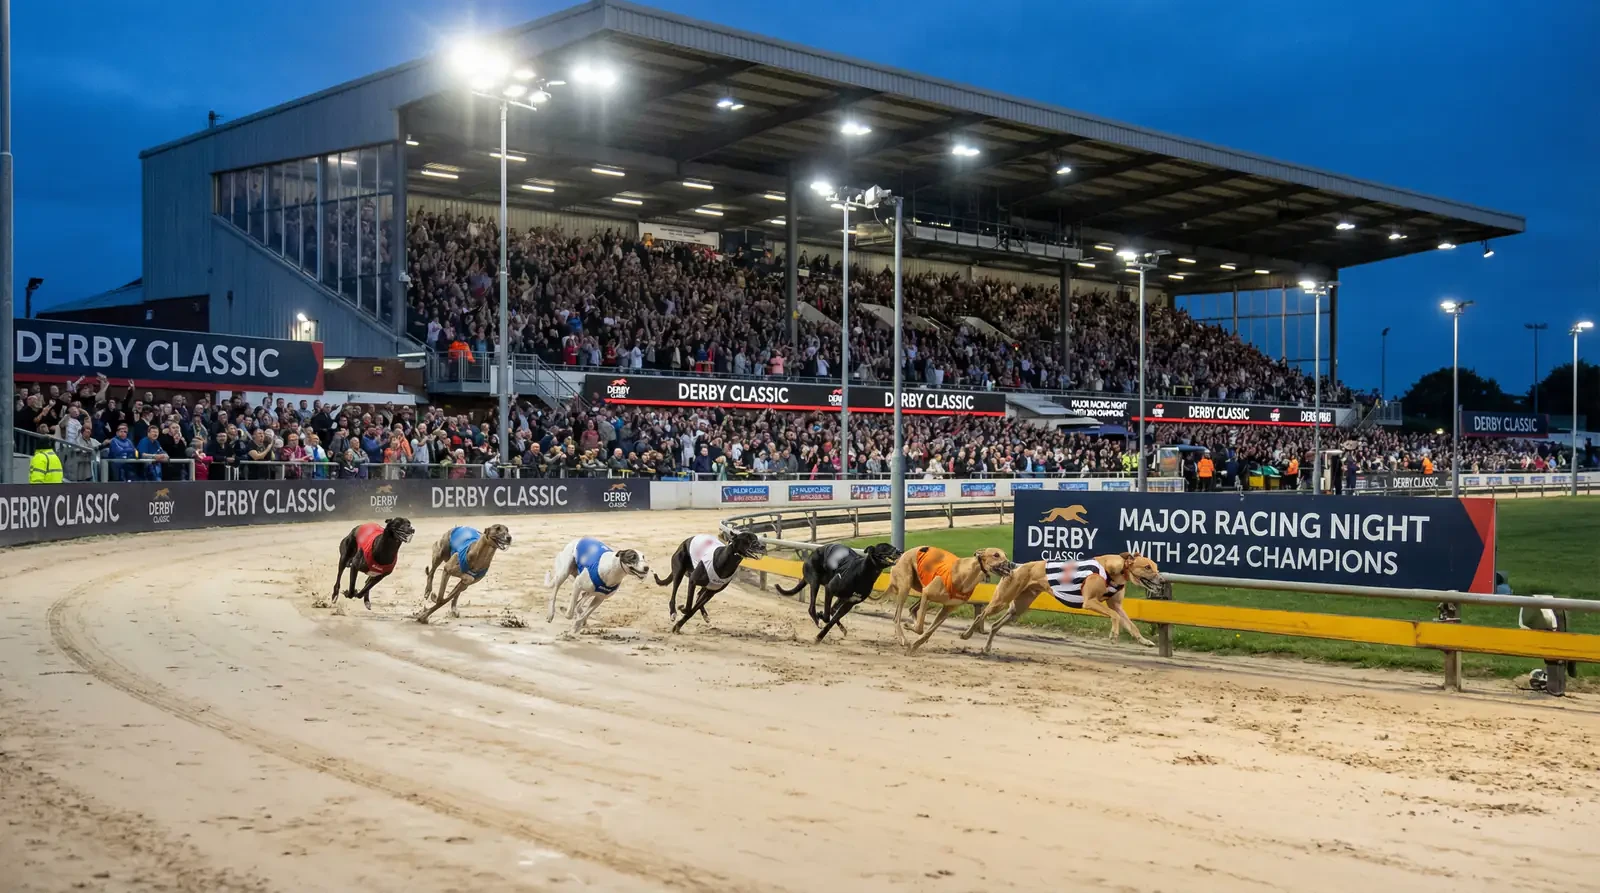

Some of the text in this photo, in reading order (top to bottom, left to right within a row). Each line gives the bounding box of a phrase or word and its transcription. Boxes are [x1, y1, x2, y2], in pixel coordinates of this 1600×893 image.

[16, 330, 280, 378] DERBY CLASSIC
[678, 383, 789, 403] DERBY CLASSIC
[885, 392, 974, 410] DRBY CLASSIC
[1111, 401, 1127, 409] NIGHT
[1188, 405, 1250, 420] DERBY CLASSIC
[1474, 416, 1538, 432] DERBY CLASSIC
[1393, 477, 1414, 488] DERBY
[1414, 477, 1438, 488] CLASSIC
[205, 487, 336, 517] DERBY CLASSIC
[370, 495, 398, 507] DERBY
[432, 485, 568, 508] DERBY CLASSIC
[603, 491, 632, 502] DERBY
[0, 492, 120, 530] DERBY CLASSIC
[149, 501, 175, 515] DERBY
[1119, 507, 1431, 544] MAJOR RACING NIGHT
[1027, 525, 1099, 550] DERBY
[1040, 550, 1085, 562] CLASSIC
[1126, 540, 1398, 575] WITH 2024 CHAMPIONS
